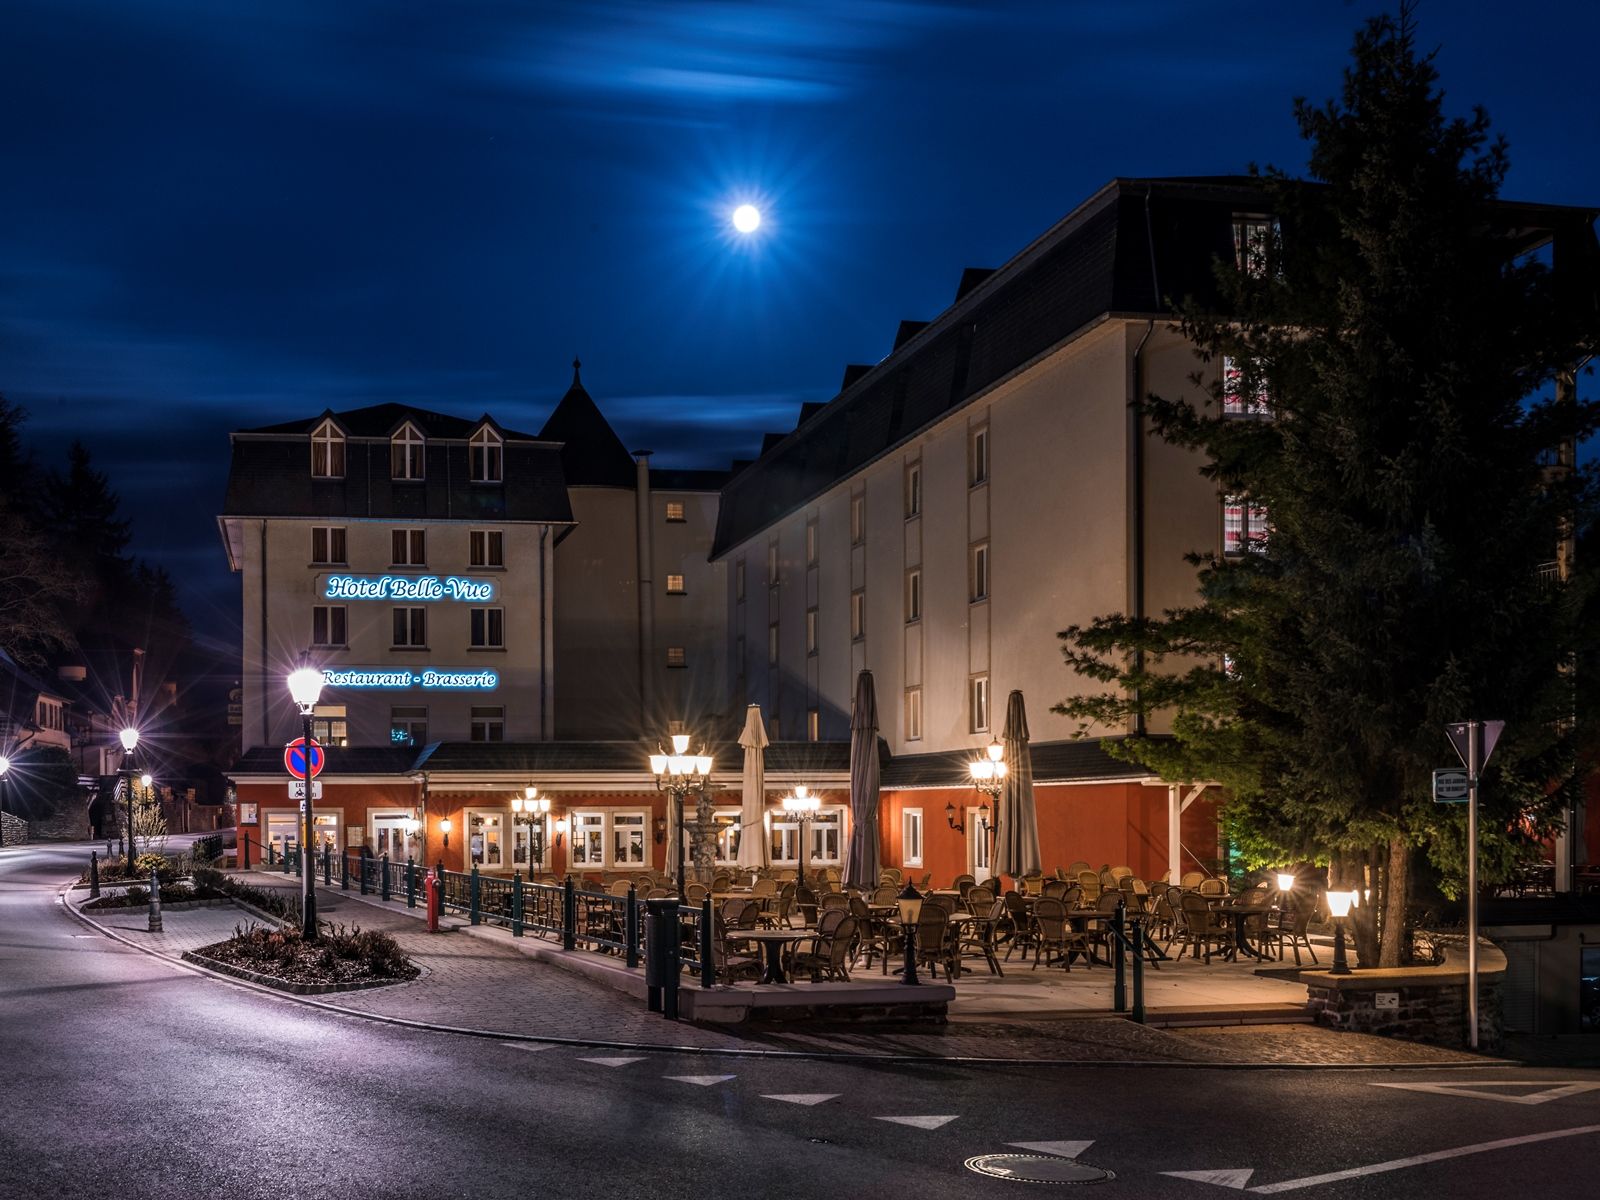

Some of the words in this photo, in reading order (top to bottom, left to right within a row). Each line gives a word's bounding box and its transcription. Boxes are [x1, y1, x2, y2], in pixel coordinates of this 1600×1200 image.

[327, 577, 390, 597] Hotel
[323, 670, 411, 686] Restaurant
[423, 670, 497, 687] Brasserie
